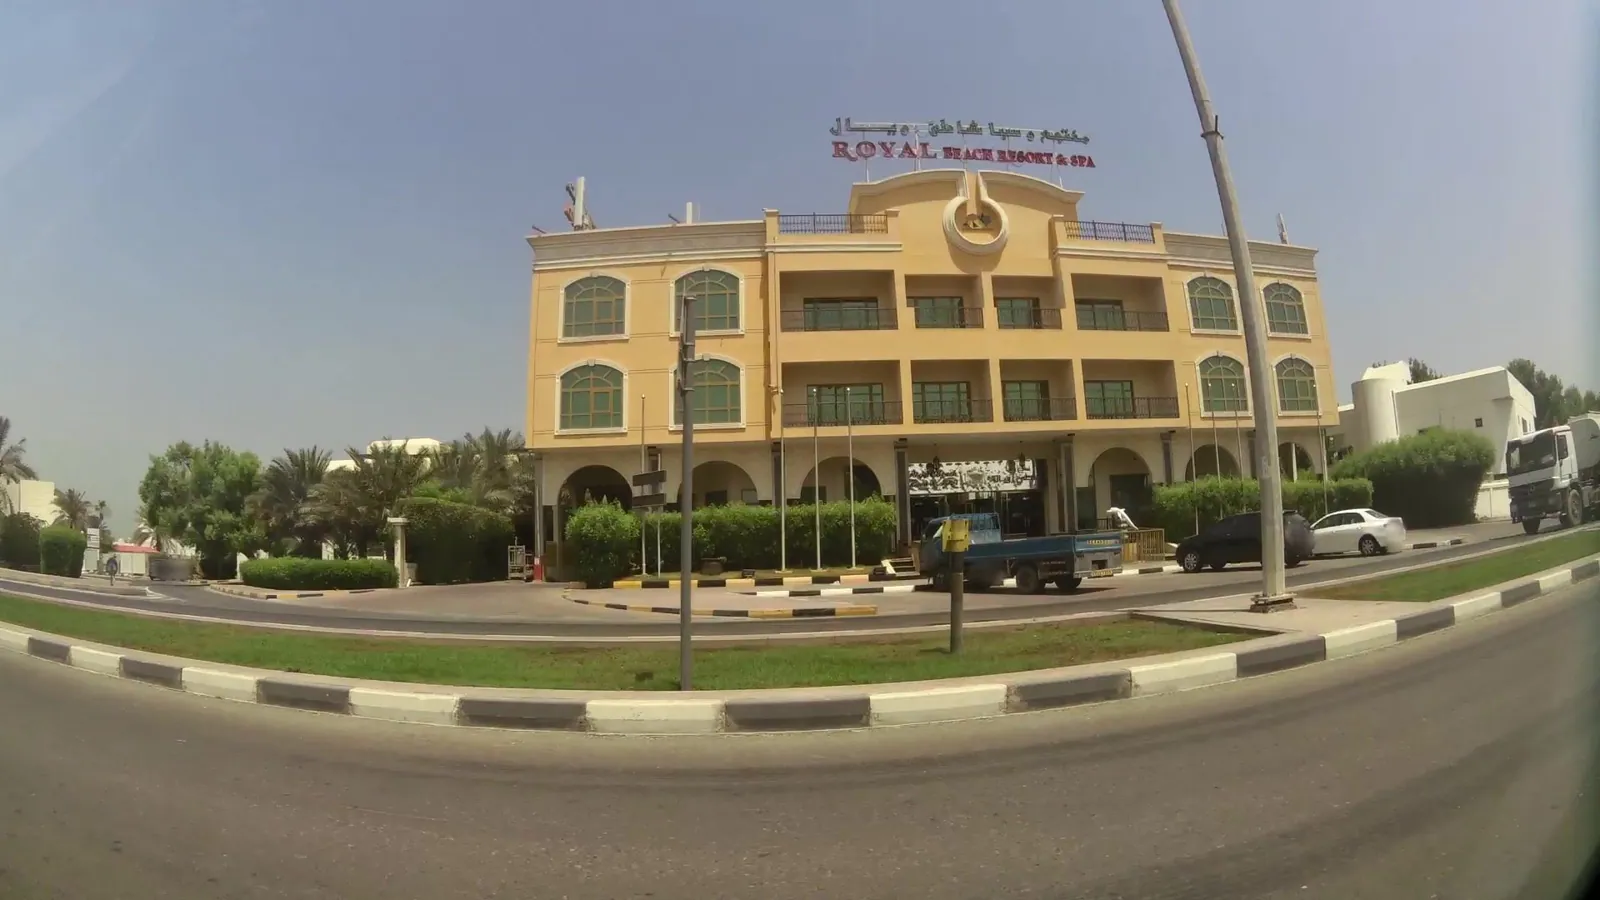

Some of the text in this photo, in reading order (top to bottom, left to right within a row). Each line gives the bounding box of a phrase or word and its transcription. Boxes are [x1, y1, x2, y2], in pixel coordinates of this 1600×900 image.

[832, 140, 1096, 168] ROYAL BEACH RESORT & SPA
